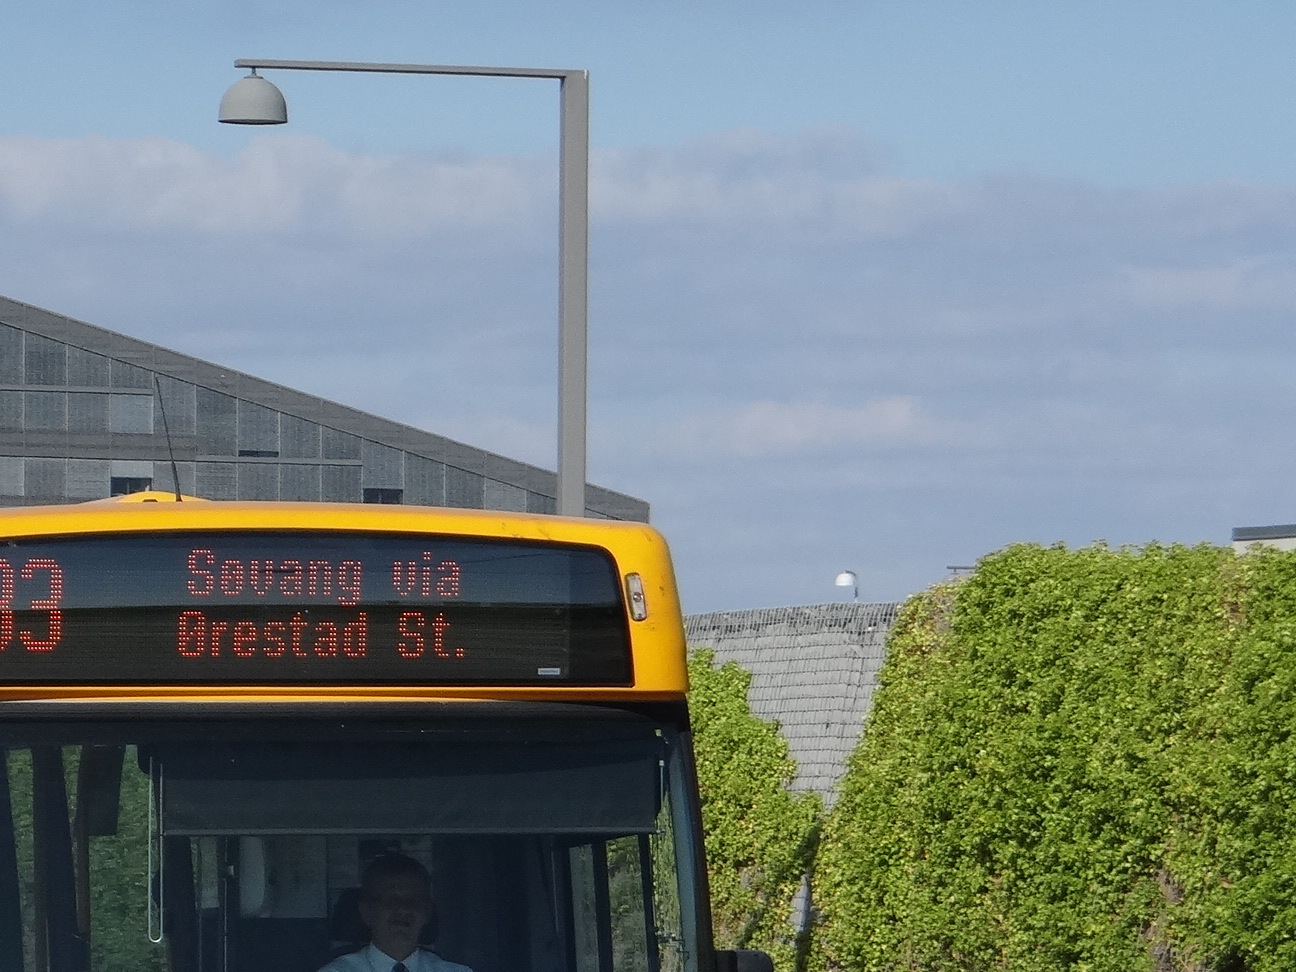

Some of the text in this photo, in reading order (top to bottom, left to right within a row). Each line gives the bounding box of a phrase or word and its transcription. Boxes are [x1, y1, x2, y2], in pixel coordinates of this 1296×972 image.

[186, 547, 461, 605] Søvang via
[177, 609, 466, 660] Ørestad St.
